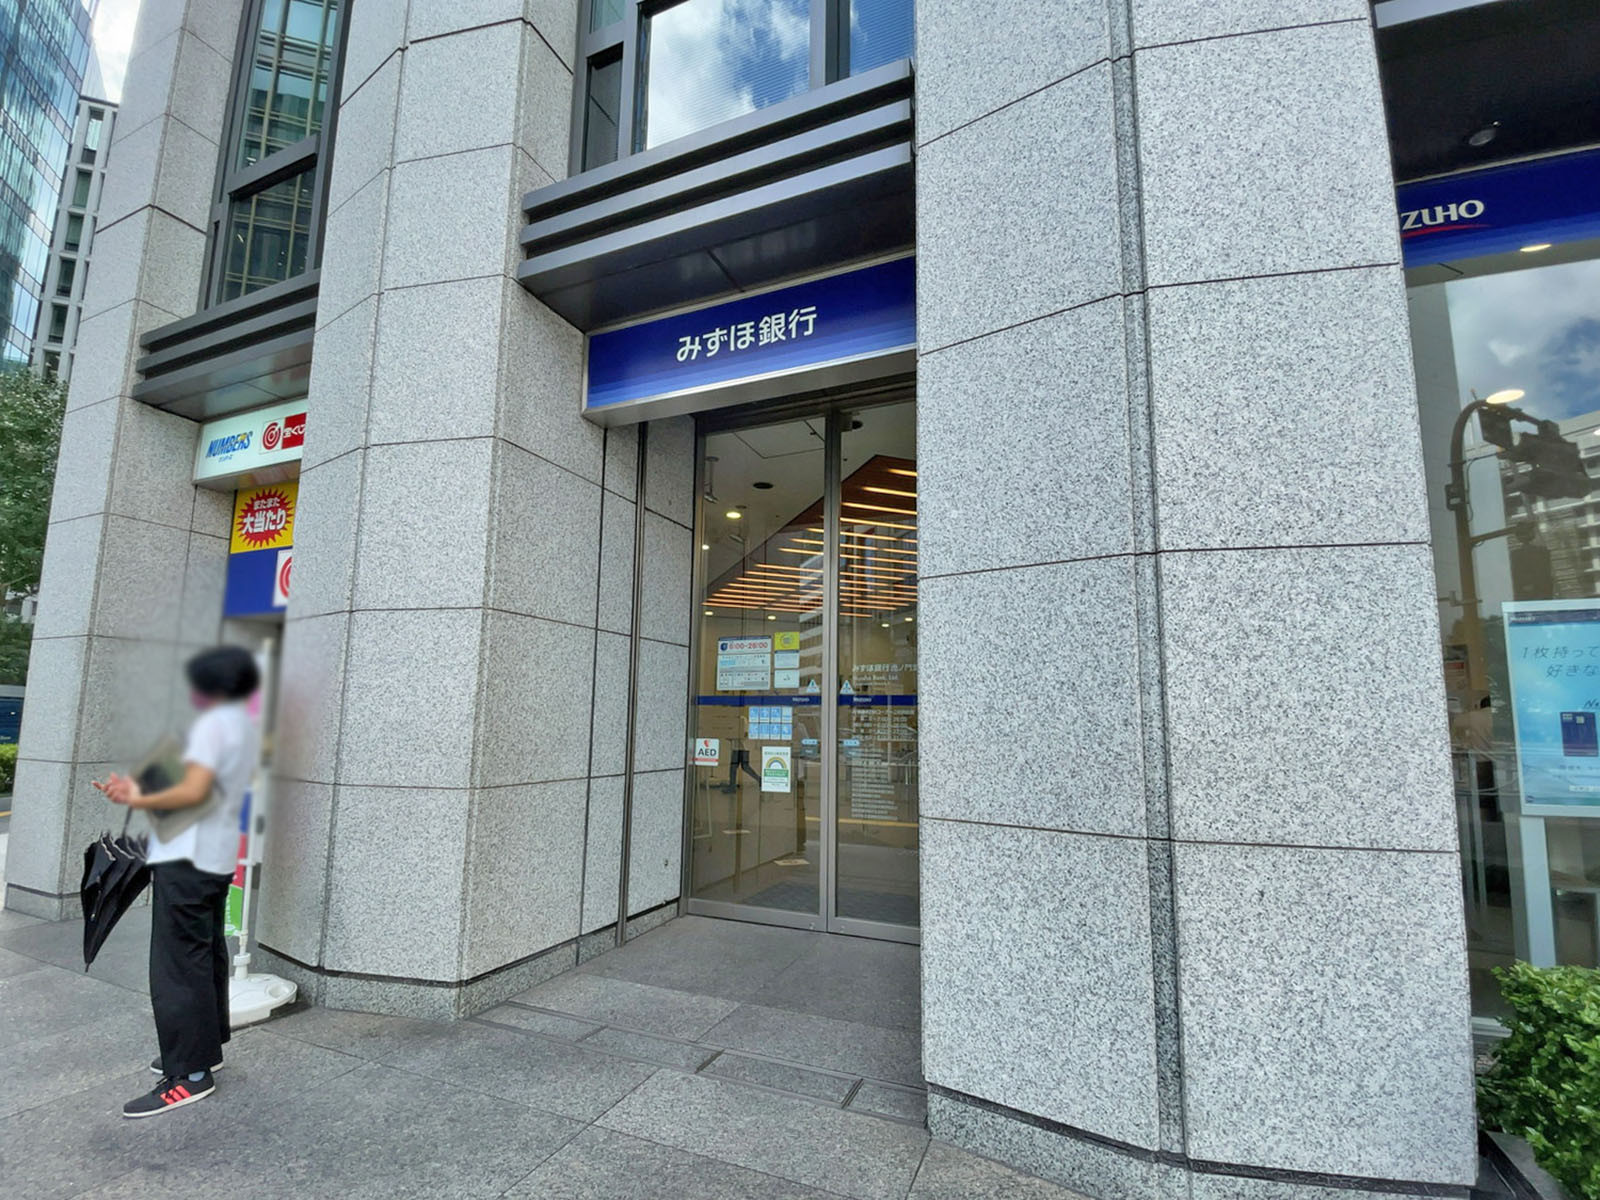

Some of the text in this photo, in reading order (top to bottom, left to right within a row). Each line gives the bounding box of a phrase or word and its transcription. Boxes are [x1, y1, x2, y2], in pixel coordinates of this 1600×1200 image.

[1400, 199, 1484, 230] ZUHO
[676, 305, 818, 362] みずほ銀行
[205, 431, 254, 458] NUMBERS
[241, 508, 287, 534] 大当たり
[1545, 664, 1600, 679] 好きな
[697, 748, 717, 757] AED
